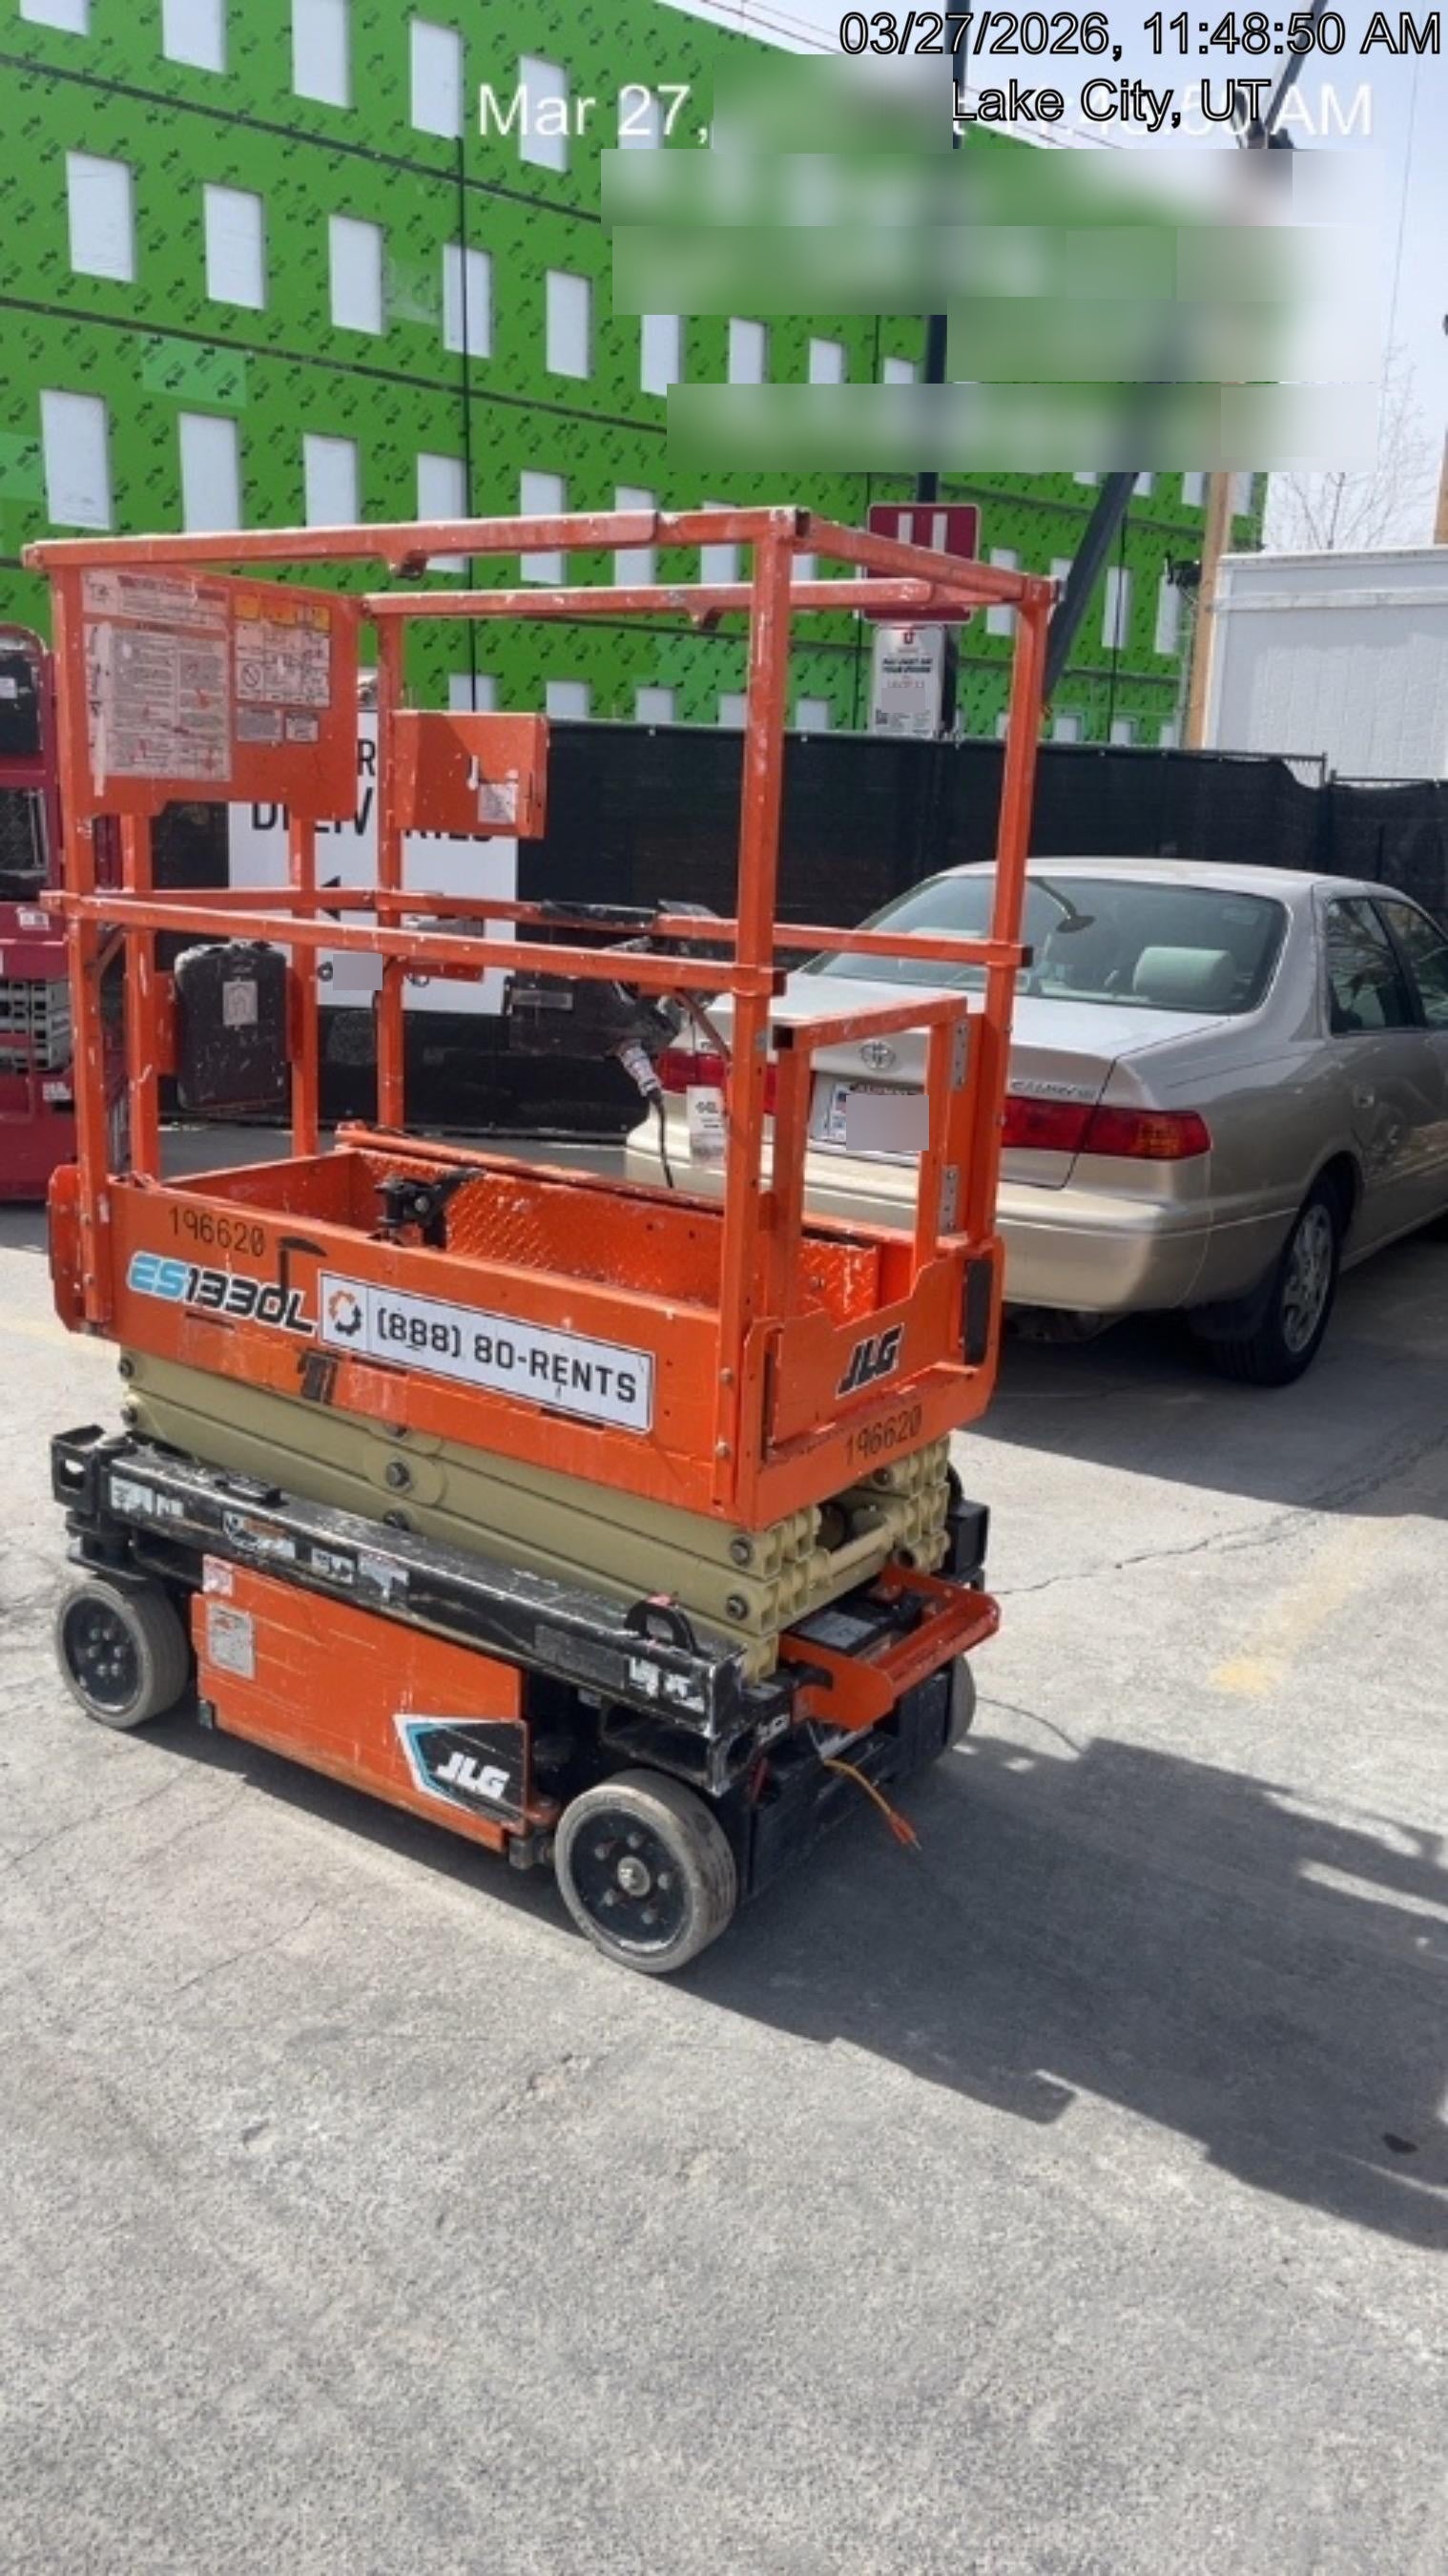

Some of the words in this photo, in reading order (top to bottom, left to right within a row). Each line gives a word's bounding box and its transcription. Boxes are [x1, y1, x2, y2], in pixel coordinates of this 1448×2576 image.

[168, 1205, 265, 1257] 196620
[127, 1251, 316, 1337] ES1330L
[377, 1306, 462, 1358] (888)
[474, 1332, 637, 1403] 80-RENTS
[837, 1322, 904, 1400] JLG
[846, 1404, 922, 1465] 196620
[436, 1751, 510, 1799] JLG
